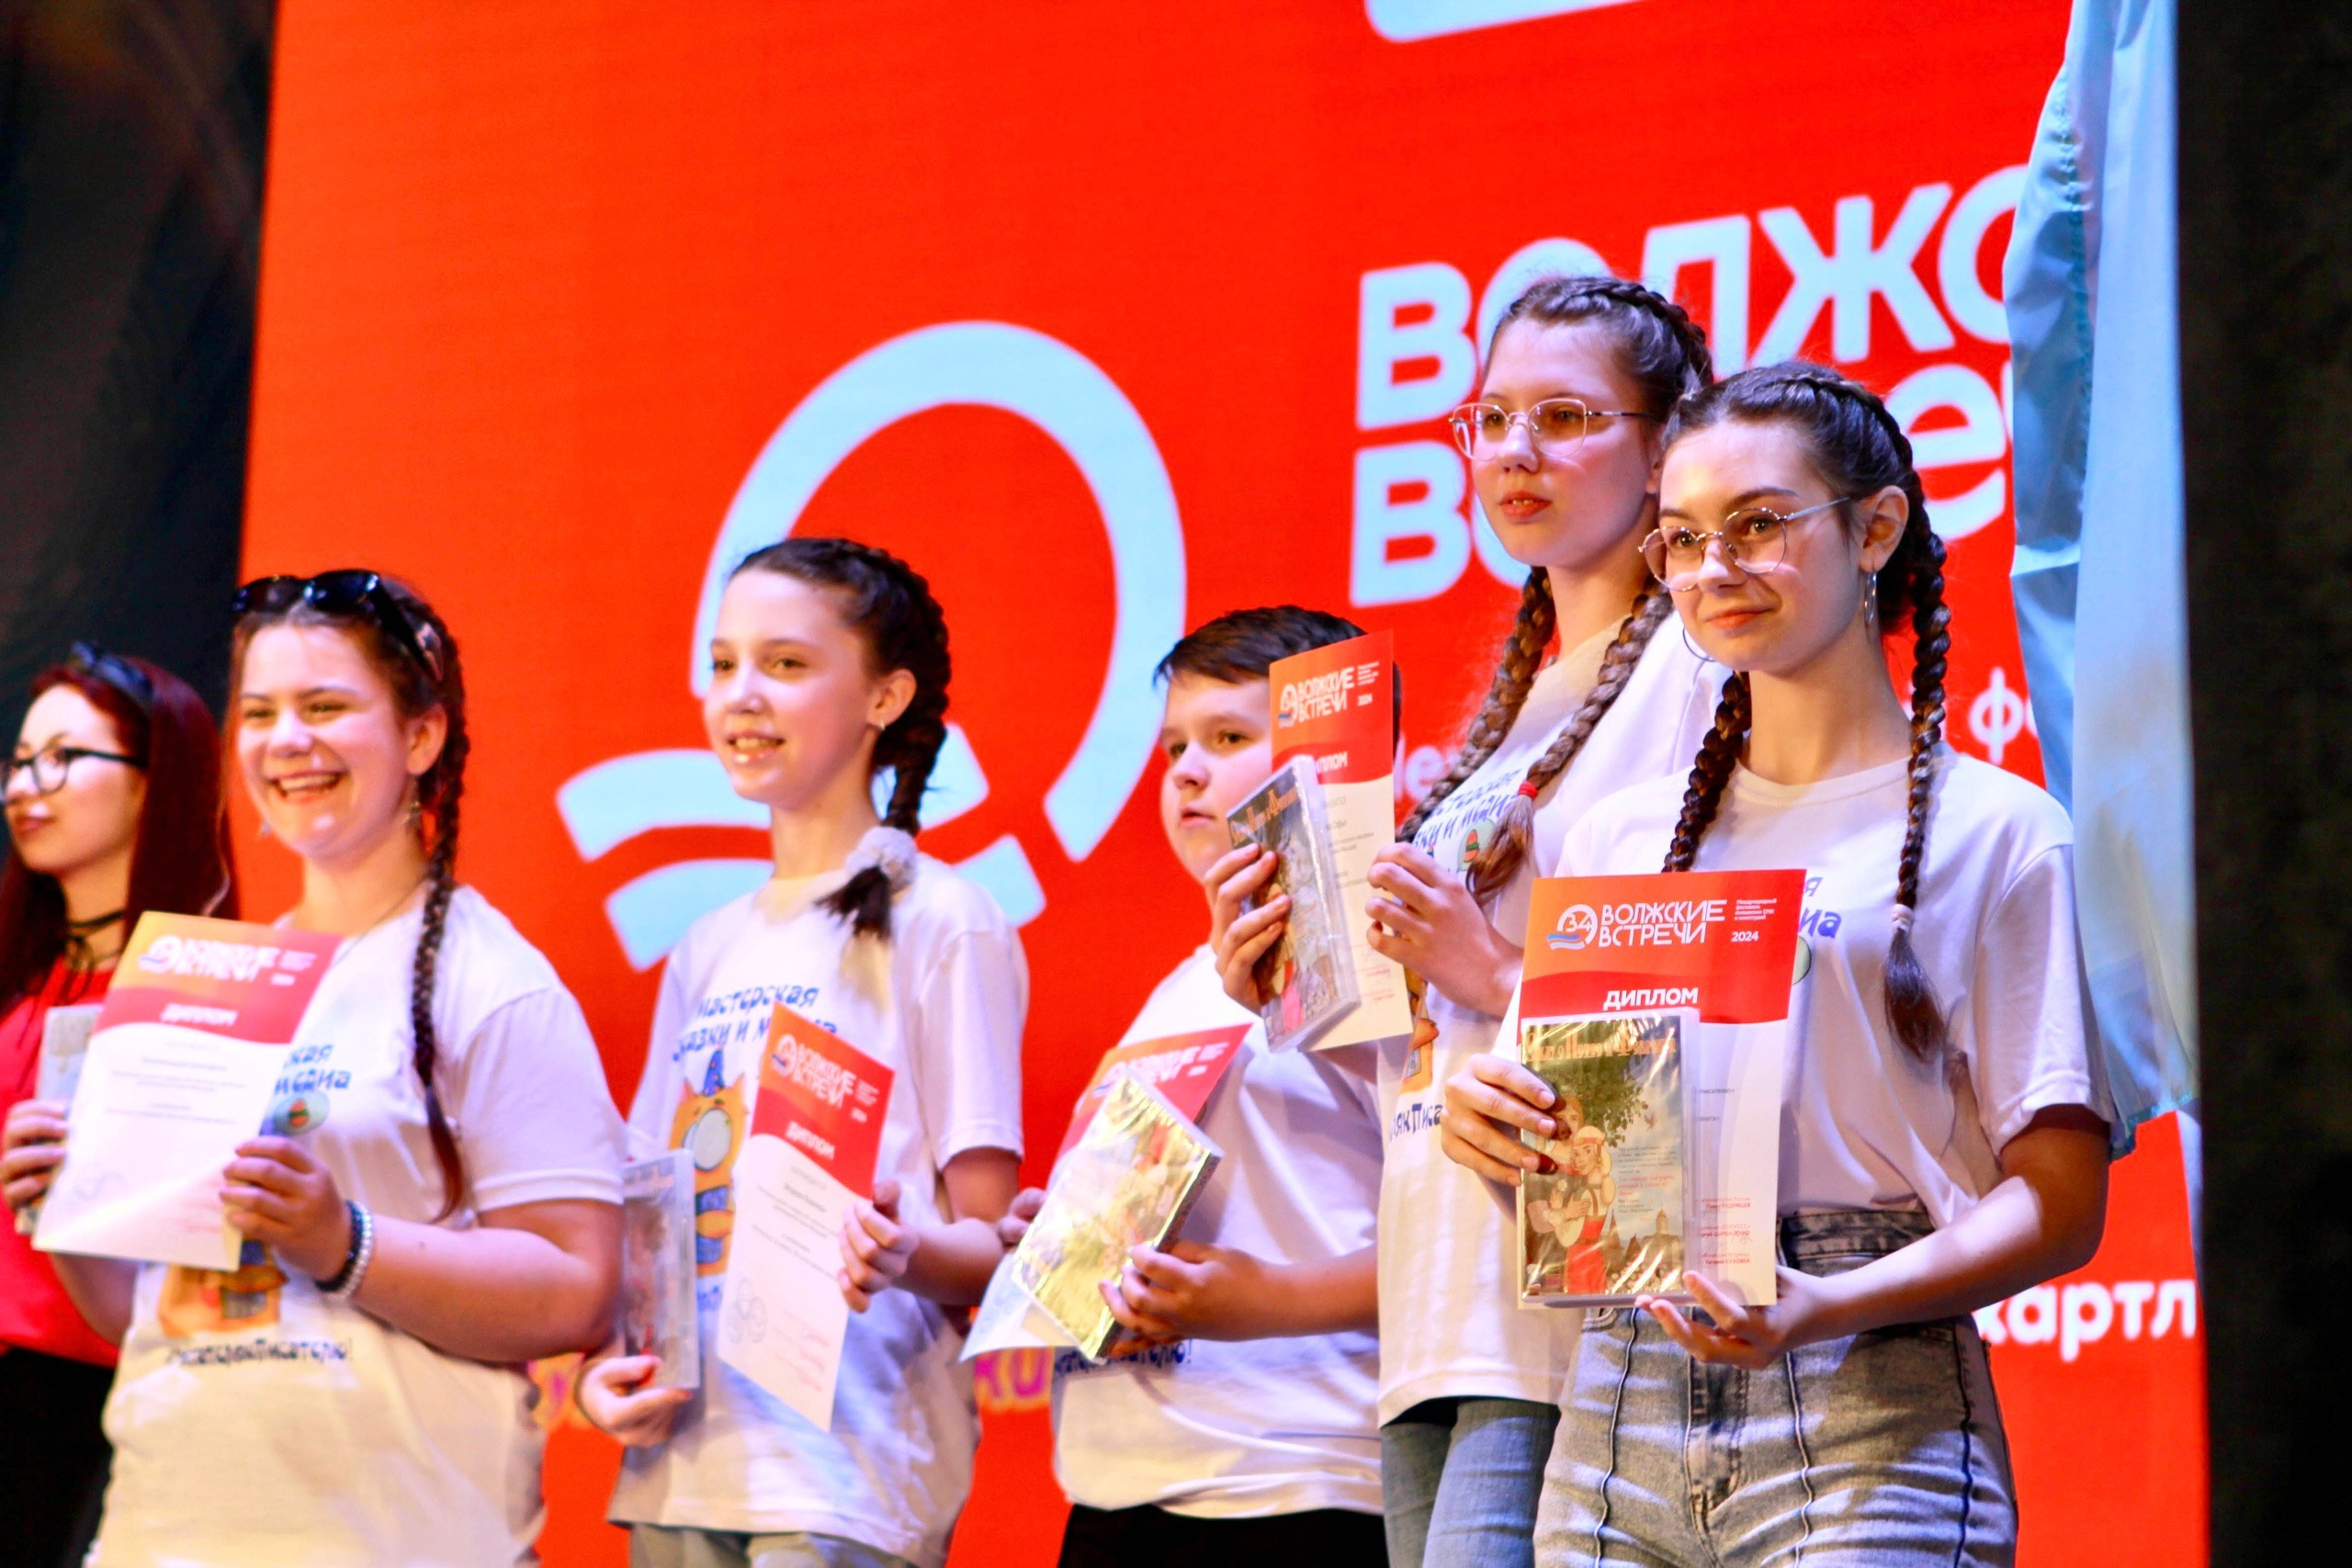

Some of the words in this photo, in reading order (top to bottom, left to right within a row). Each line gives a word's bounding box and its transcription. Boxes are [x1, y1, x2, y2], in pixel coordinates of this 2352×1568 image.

[1600, 899, 1727, 926] ВОЛЖСКИЕ
[1599, 922, 1707, 947] ВСТРЕЧИ
[1731, 931, 1759, 942] 2024
[1602, 987, 1699, 1010] ДИПЛОМ
